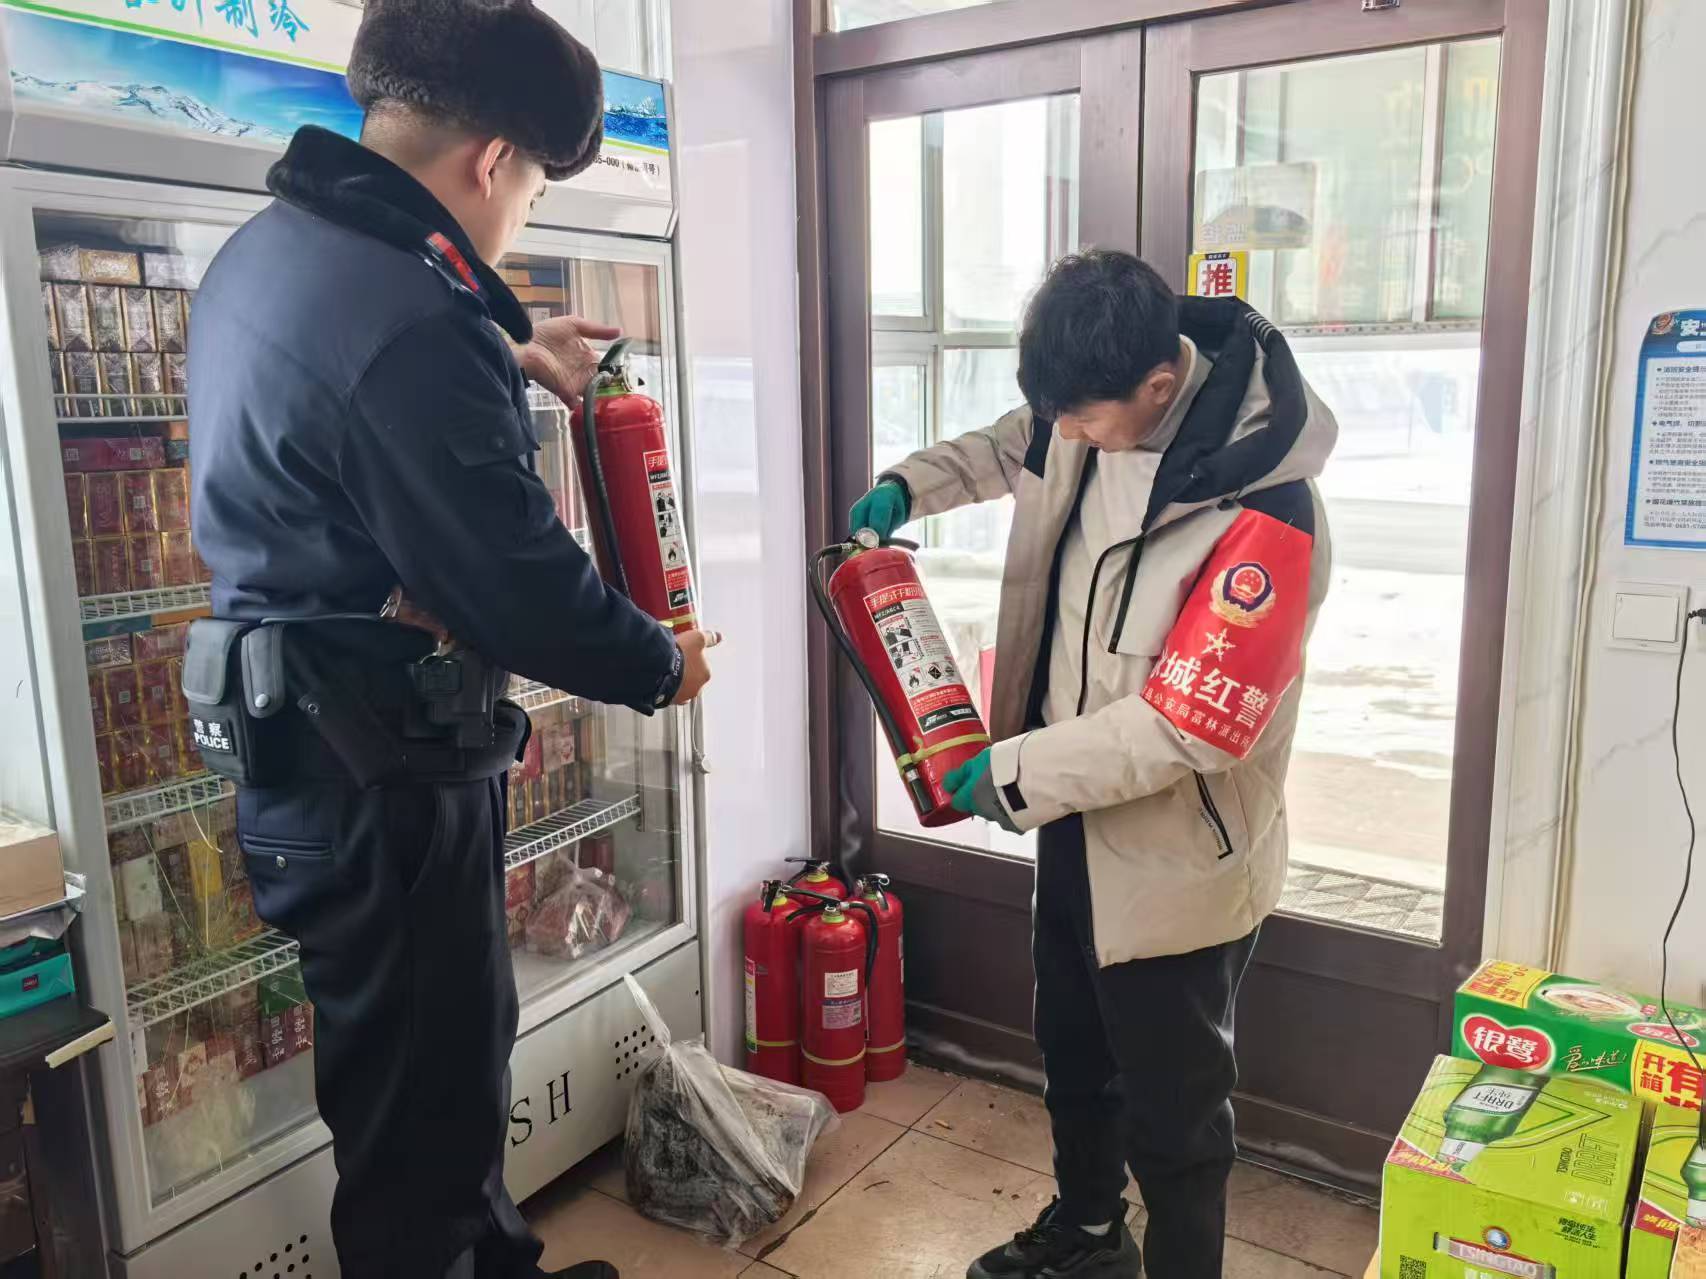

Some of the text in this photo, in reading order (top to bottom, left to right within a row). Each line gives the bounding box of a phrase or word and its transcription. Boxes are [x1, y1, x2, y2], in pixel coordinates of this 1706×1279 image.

[1202, 263, 1233, 296] 推
[193, 719, 222, 737] 警察
[194, 732, 230, 749] POLICE
[1471, 1026, 1541, 1063] 银鹭
[1472, 1089, 1516, 1111] DRAFT
[1556, 1146, 1573, 1174] TSINGTAO
[1571, 1132, 1616, 1186] DRAFT
